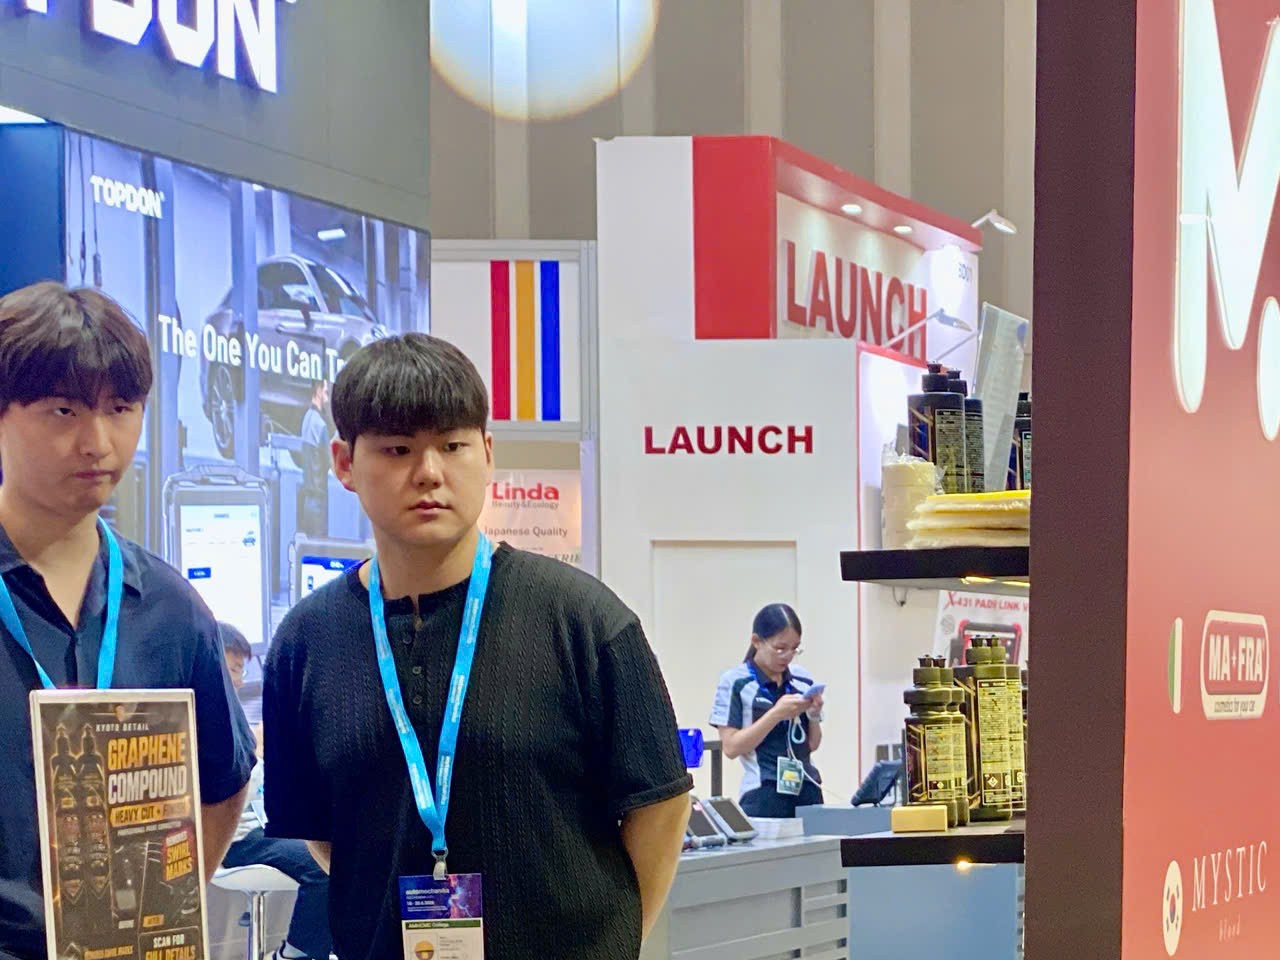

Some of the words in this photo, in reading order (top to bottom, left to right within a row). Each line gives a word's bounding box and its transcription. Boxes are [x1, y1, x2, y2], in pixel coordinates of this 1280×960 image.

[90, 175, 164, 219] TOPDON
[783, 239, 927, 363] LAUNCH
[158, 314, 198, 358] The
[203, 323, 242, 367] One
[245, 331, 283, 374] You
[287, 340, 323, 381] Can
[643, 425, 814, 455] LAUNCH
[492, 482, 559, 501] Linda
[485, 526, 530, 537] Japanese
[532, 526, 568, 538] Quality
[107, 731, 187, 771] GRAPHENE
[108, 765, 187, 805] COMPOUND
[140, 805, 155, 820] CUT
[1192, 840, 1267, 912] MYSTIC
[153, 935, 170, 949] SCAN
